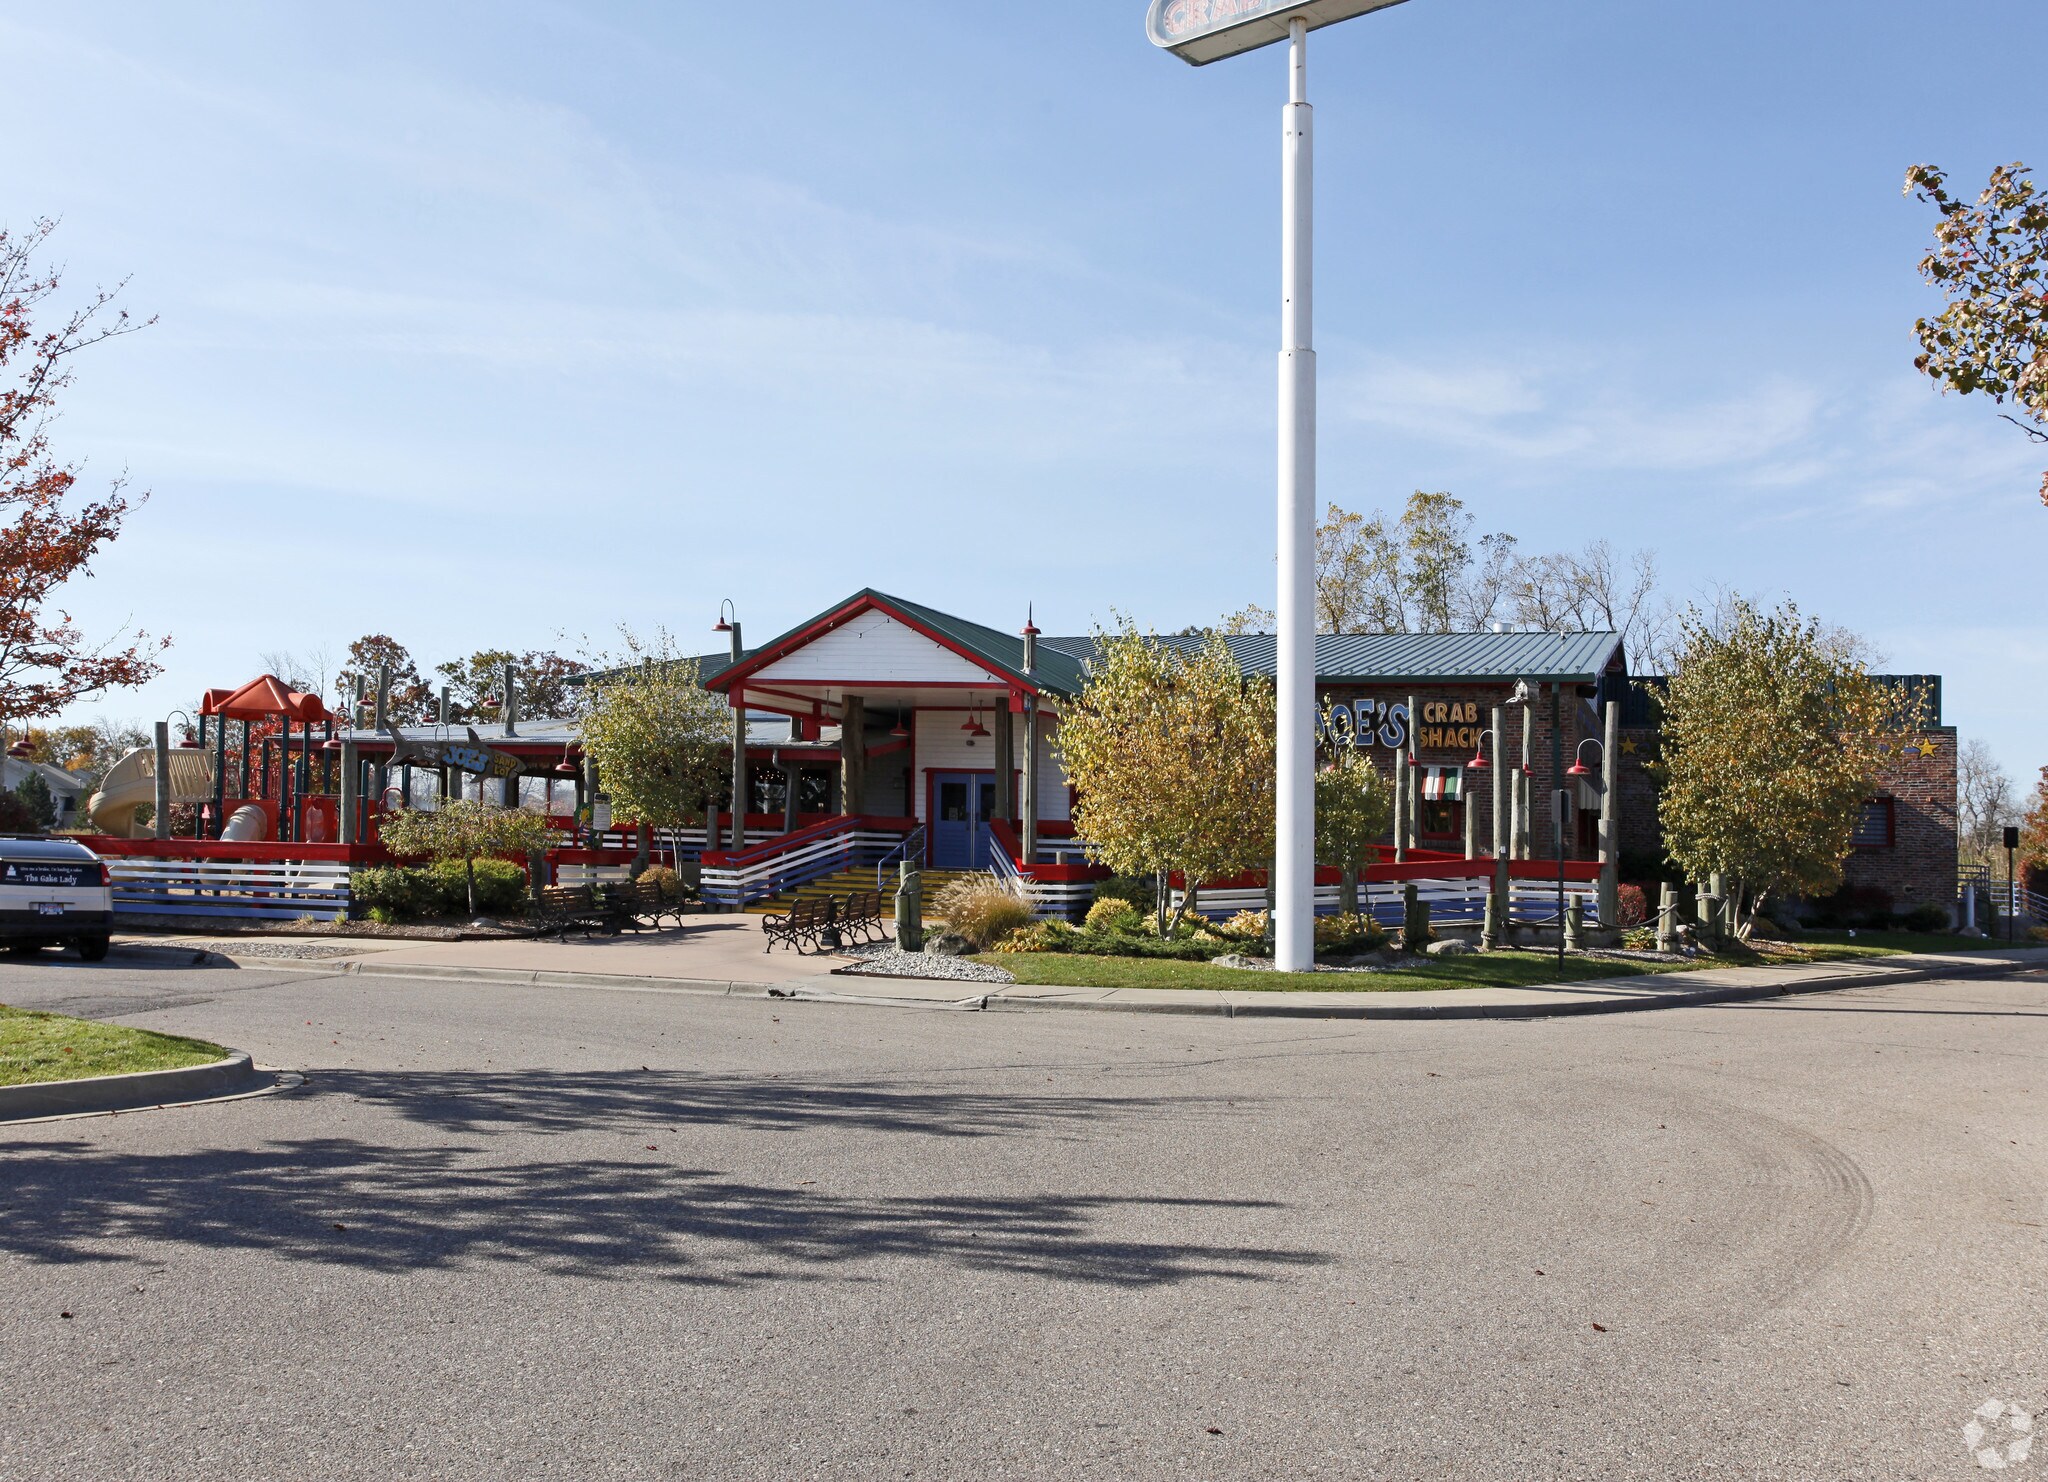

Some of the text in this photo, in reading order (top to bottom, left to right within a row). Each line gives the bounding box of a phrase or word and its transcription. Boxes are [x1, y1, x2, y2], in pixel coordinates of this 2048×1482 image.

[1423, 702, 1478, 723] CRAB
[1420, 727, 1484, 748] SHACK
[494, 754, 517, 768] SAND
[24, 874, 38, 882] The
[60, 875, 77, 886] Lady
